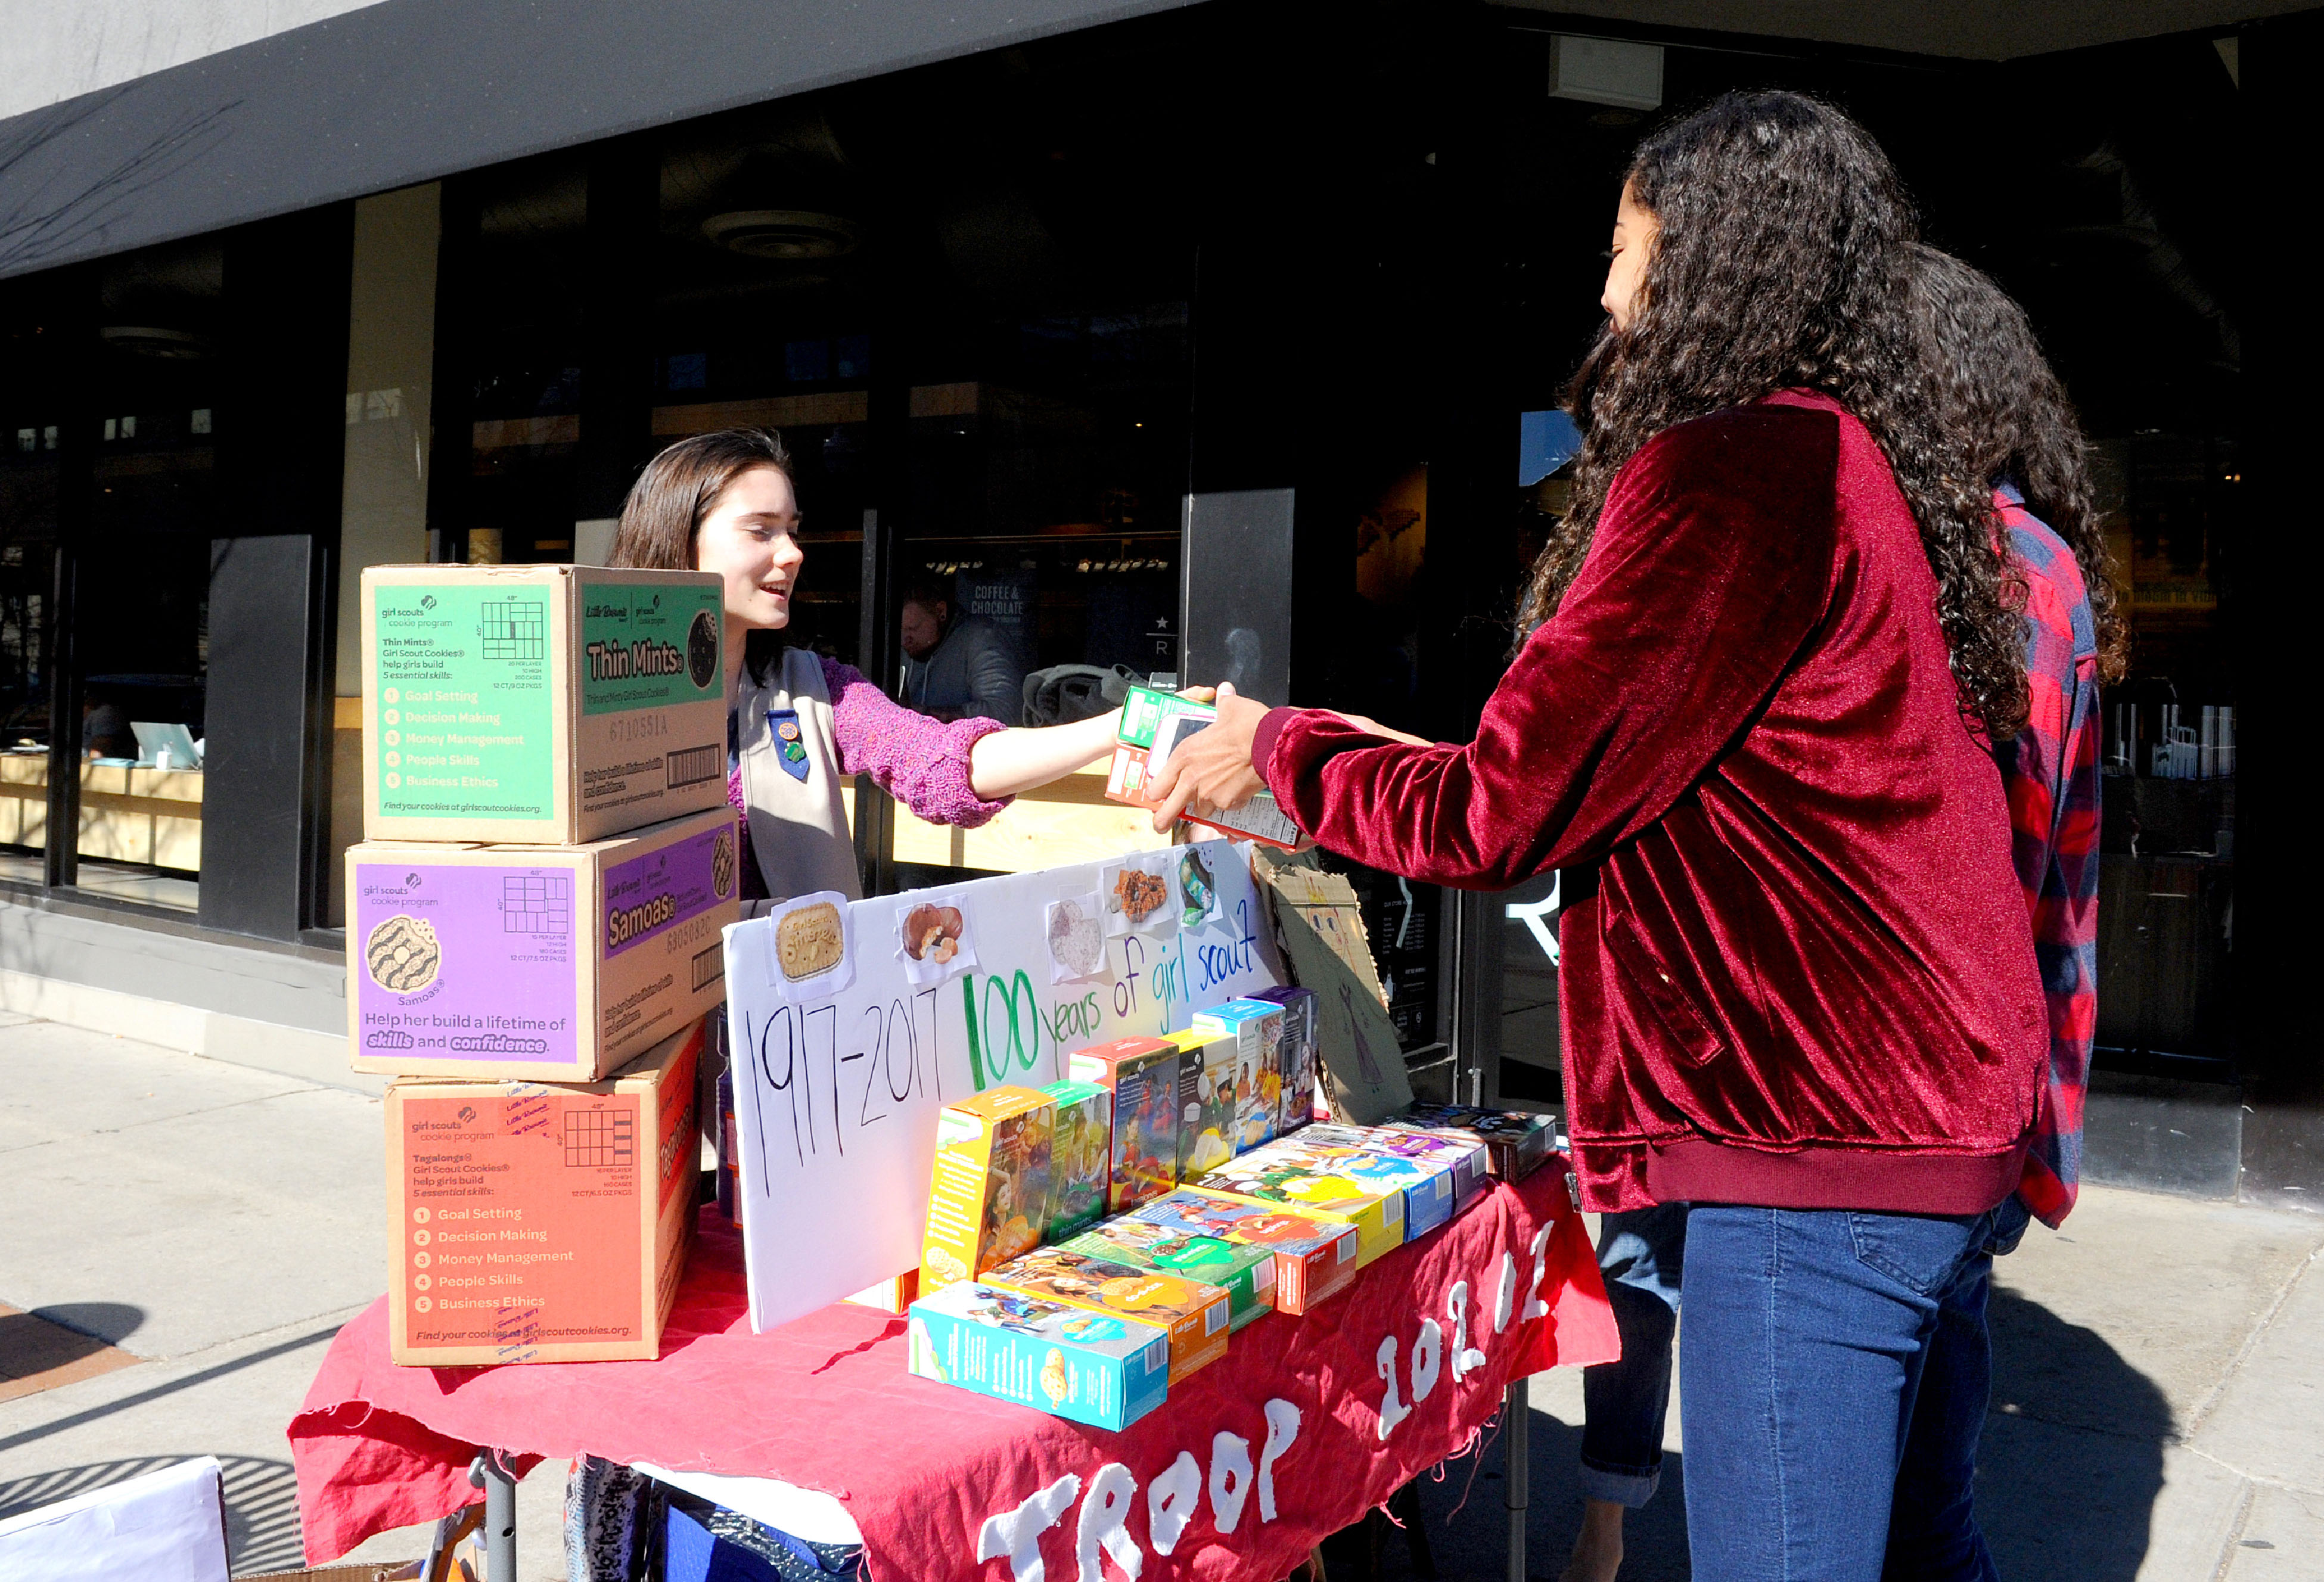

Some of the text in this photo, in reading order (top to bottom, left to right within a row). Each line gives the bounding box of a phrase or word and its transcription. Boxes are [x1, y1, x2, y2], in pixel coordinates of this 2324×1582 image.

[975, 586, 1020, 599] COFFEE &
[382, 608, 396, 618] girl
[971, 601, 1024, 614] CHOCOLATE
[418, 620, 452, 629] program
[1156, 641, 1168, 655] R
[383, 660, 401, 669] help
[403, 660, 421, 670] girls
[586, 639, 630, 682] Thin
[405, 691, 433, 701] Goal
[435, 691, 478, 704] Setting
[405, 712, 456, 723] Decision
[459, 712, 501, 725] Making
[406, 733, 524, 748] Money Management
[406, 755, 480, 766] People Skills
[406, 775, 459, 787] Business
[461, 776, 499, 787] Ethics
[364, 885, 378, 896] girl
[372, 896, 438, 908] cookie program
[962, 899, 1256, 1092] 100 years of girl scout
[366, 1013, 566, 1030] Help her build a lifetime of
[366, 1030, 549, 1053] skills and confidence.
[746, 988, 941, 1198] 1917-2017
[412, 1121, 428, 1133] girl
[455, 1133, 494, 1143] program
[414, 1177, 434, 1186] help
[437, 1177, 457, 1187] girls
[421, 1189, 465, 1197] essential
[467, 1188, 494, 1196] skills:
[439, 1209, 469, 1220] Goal
[473, 1208, 522, 1220] Setting
[439, 1231, 496, 1242] Decision
[500, 1229, 548, 1242] Making
[439, 1254, 483, 1266] Money
[487, 1251, 574, 1264] Management
[439, 1276, 485, 1288] People
[489, 1274, 523, 1285] Skills
[440, 1298, 499, 1309] Business
[504, 1296, 545, 1307] Ethics
[417, 1331, 440, 1340] Find
[442, 1332, 465, 1341] your
[977, 1398, 1301, 1582] TROOP
